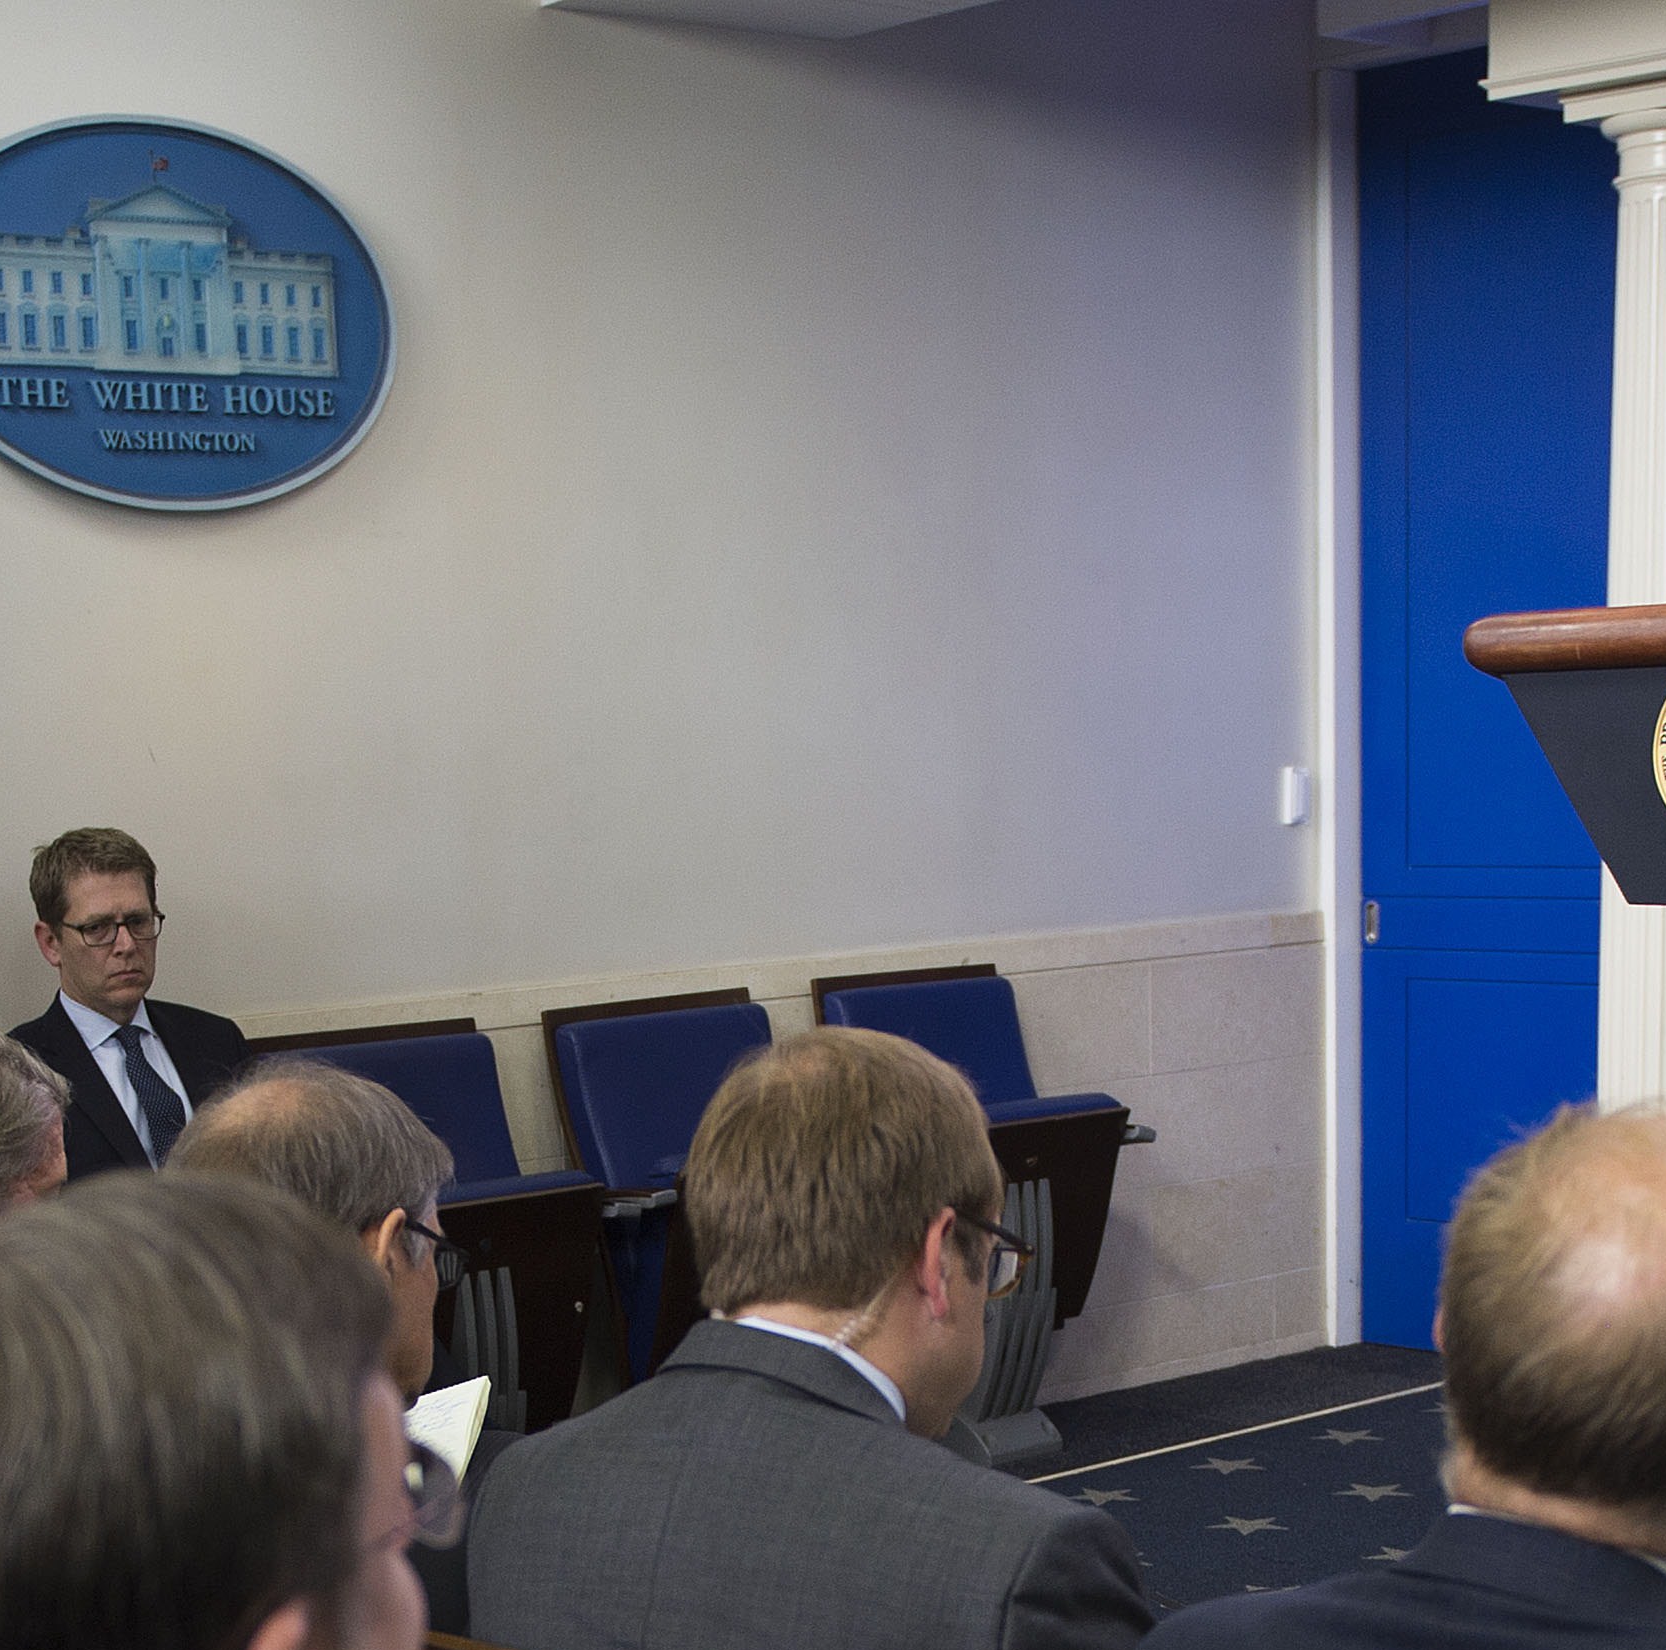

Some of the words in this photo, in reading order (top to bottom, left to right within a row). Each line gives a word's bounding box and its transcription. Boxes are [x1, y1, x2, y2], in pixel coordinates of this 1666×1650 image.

[88, 379, 209, 414] WHITE
[222, 385, 336, 418] HOUSE
[98, 428, 257, 454] WASHINGTON
